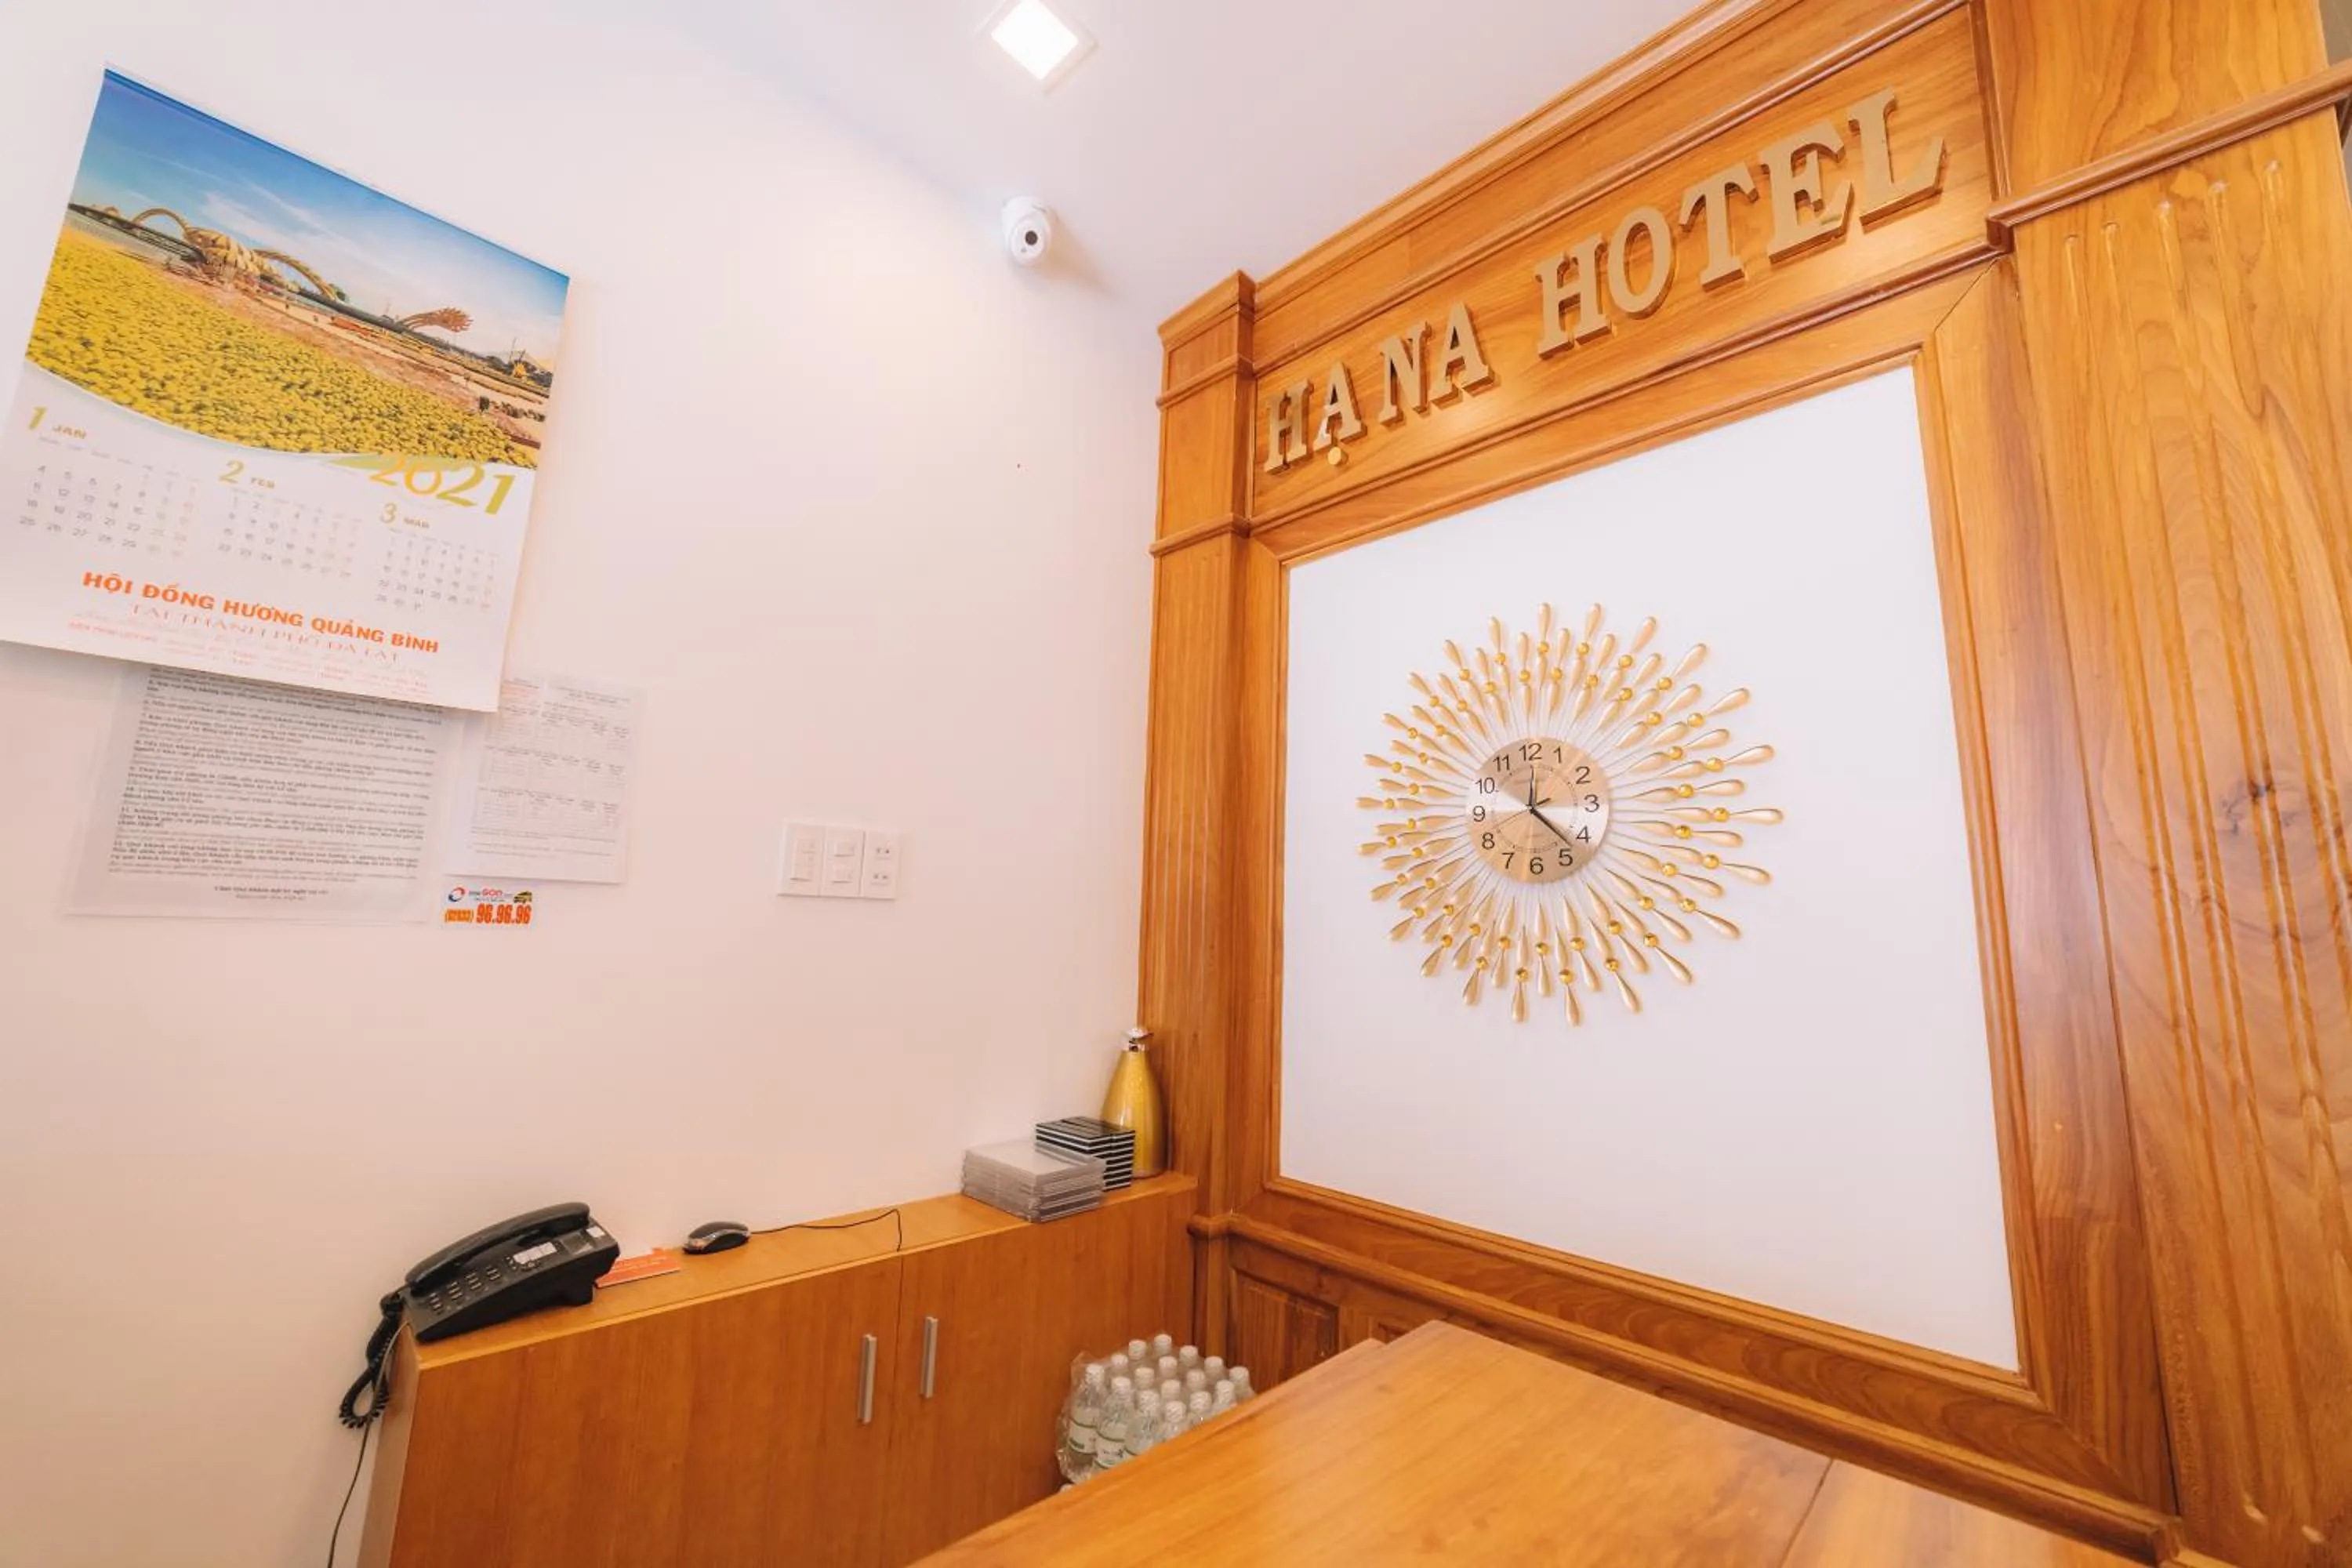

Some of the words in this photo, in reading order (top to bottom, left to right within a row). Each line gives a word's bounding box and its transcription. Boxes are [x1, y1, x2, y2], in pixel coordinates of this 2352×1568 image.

[1534, 89, 1947, 358] HOTEL
[27, 406, 48, 430] 1
[52, 425, 87, 439] JAN
[219, 460, 245, 484] 2
[369, 455, 515, 515] 2021
[381, 503, 397, 524] 3
[82, 572, 133, 594] HỘI
[223, 599, 304, 627] HƯƠNG
[311, 617, 385, 643] QUẢNG
[391, 632, 439, 653] BÌNH
[1519, 742, 1542, 761] 12
[1554, 747, 1562, 763] 1
[1493, 755, 1511, 772] 11
[1575, 766, 1591, 785] 2
[1475, 778, 1495, 794] 10
[1584, 794, 1600, 812] 3
[1472, 805, 1486, 822] 9
[1482, 832, 1495, 850] 8
[1576, 826, 1592, 844] 4
[1502, 852, 1515, 869] 7
[1530, 856, 1544, 874] 6
[1559, 848, 1573, 867] 5
[476, 903, 532, 924] 96.96.96
